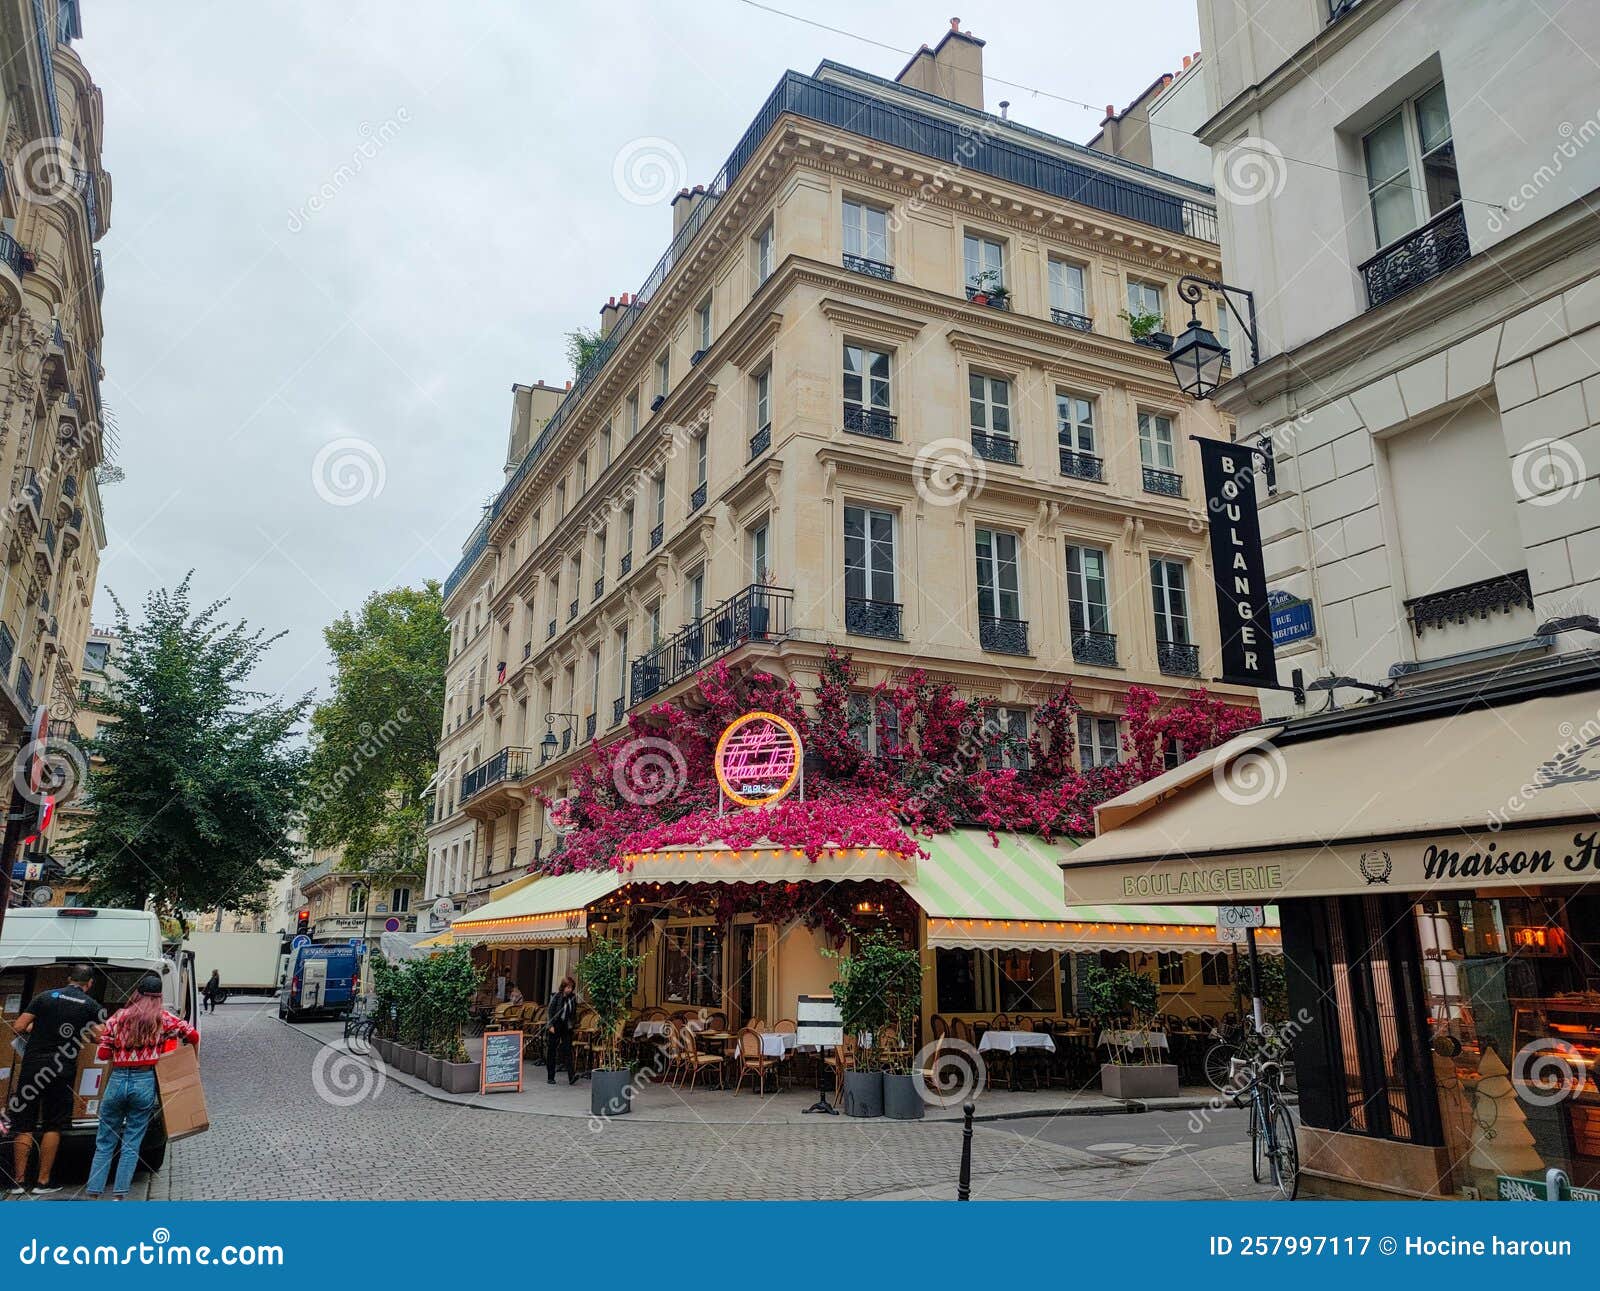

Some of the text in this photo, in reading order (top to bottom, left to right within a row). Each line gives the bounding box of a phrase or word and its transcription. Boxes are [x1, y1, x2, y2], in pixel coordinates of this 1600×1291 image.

[1221, 456, 1258, 671] BOULANGER
[1272, 621, 1310, 640] MBUTEAU
[1276, 613, 1292, 626] RUE
[742, 784, 767, 794] PARIS
[1424, 842, 1554, 879] Maison
[1564, 832, 1600, 871] H
[1123, 865, 1283, 897] BOULANGERIE
